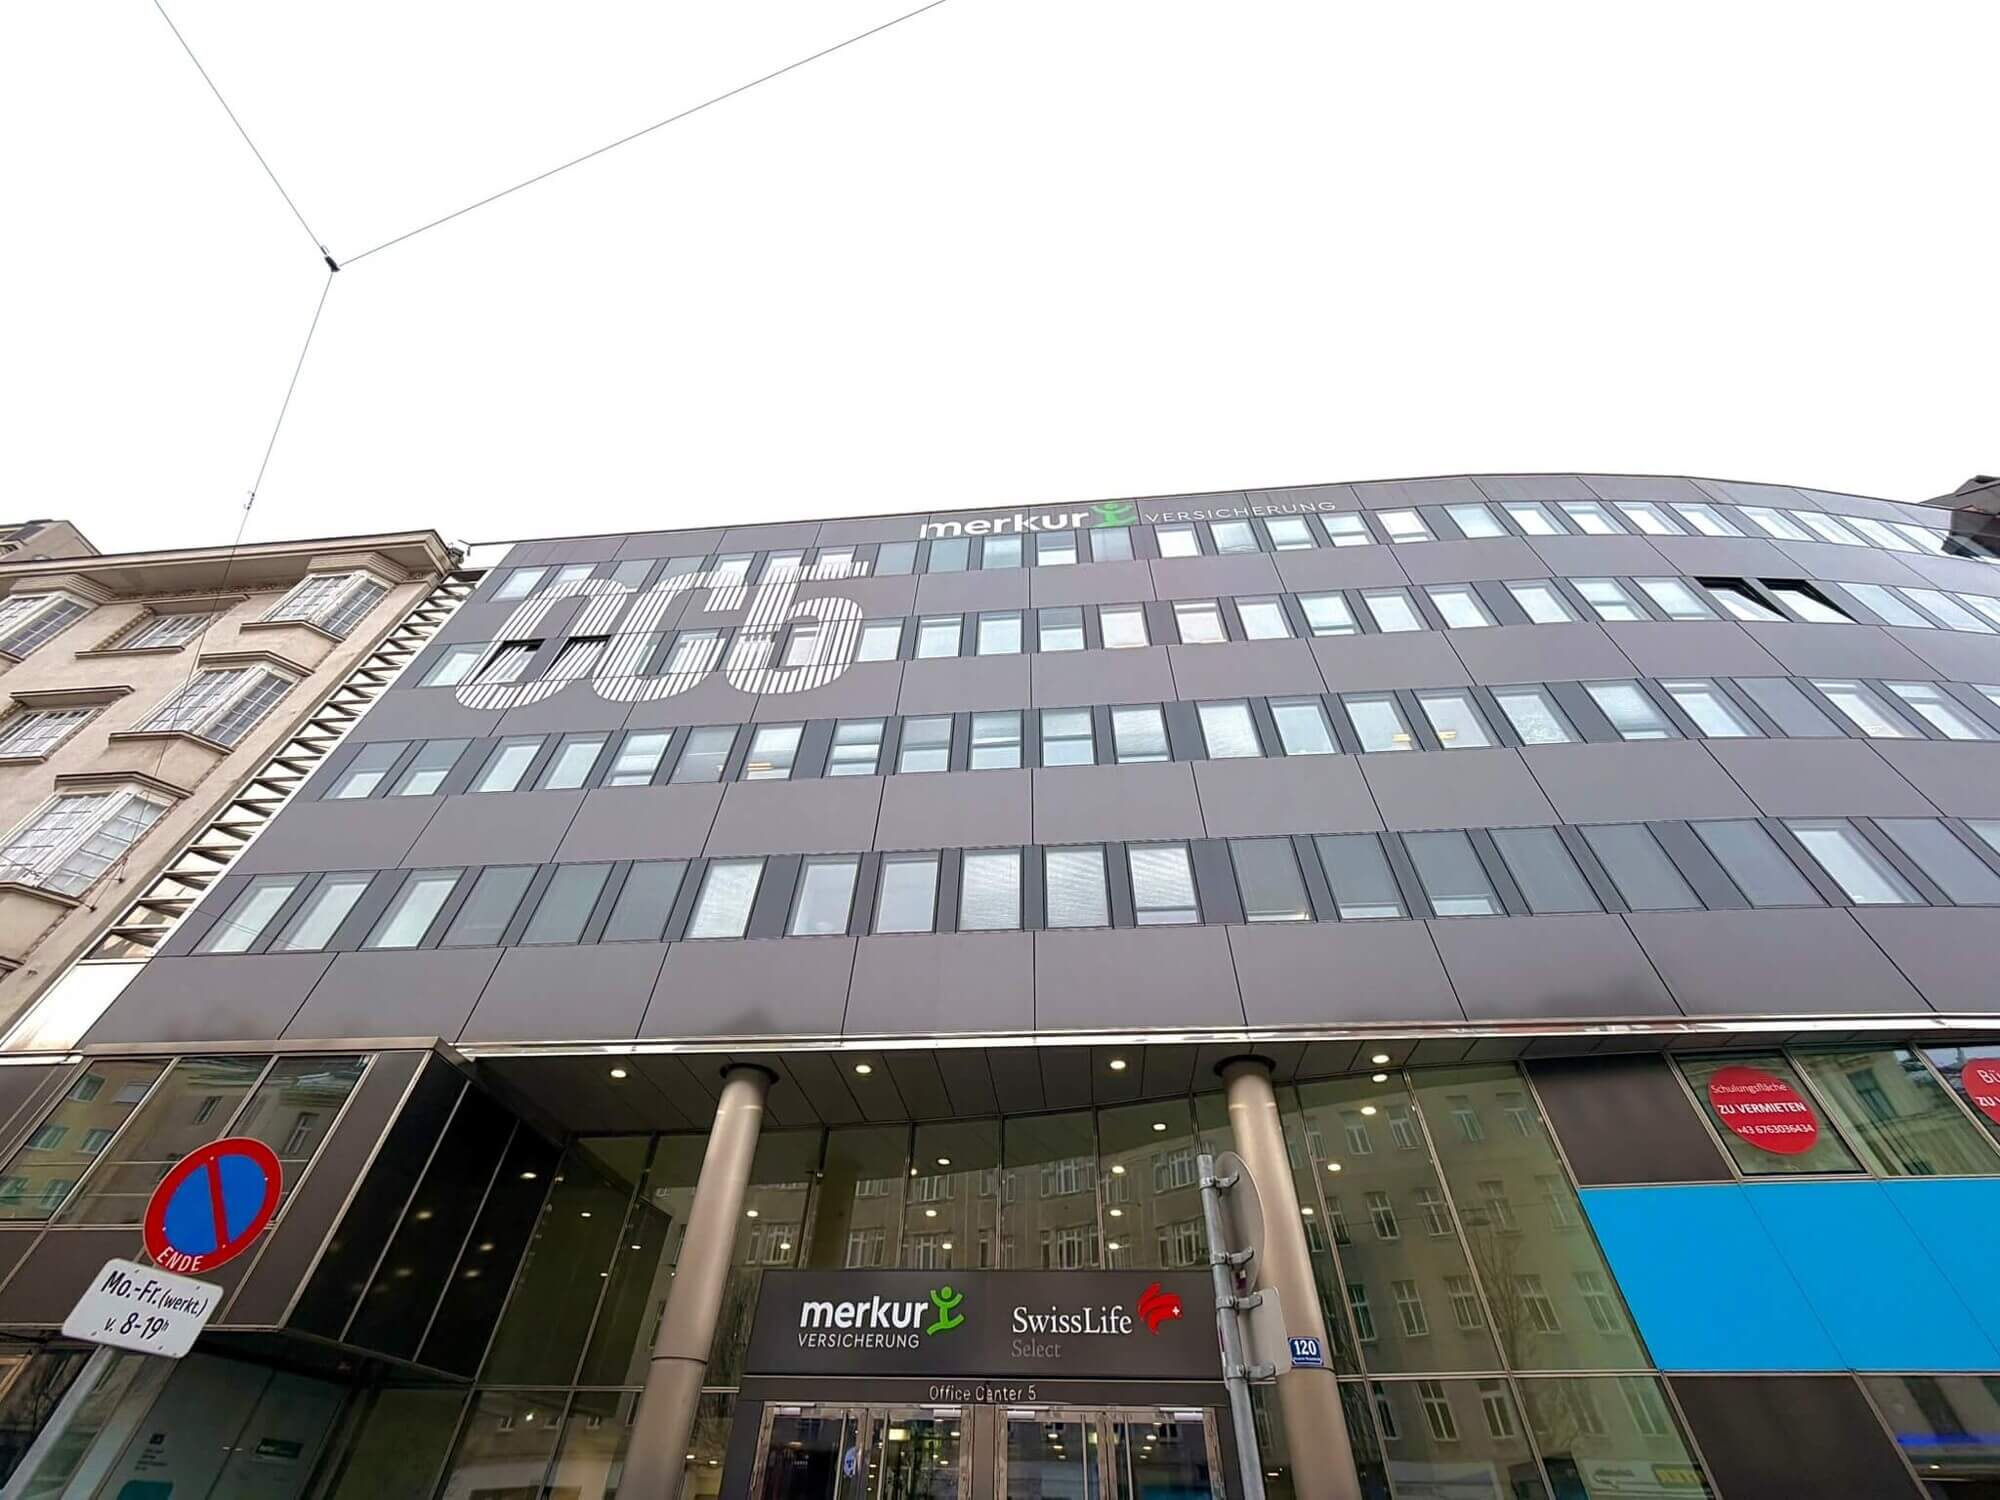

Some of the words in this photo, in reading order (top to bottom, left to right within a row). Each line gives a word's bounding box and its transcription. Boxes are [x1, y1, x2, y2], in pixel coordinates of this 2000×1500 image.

[919, 511, 1090, 540] merkur
[1145, 501, 1337, 523] VERSICHERUNG
[1717, 1104, 1736, 1115] ZU
[1735, 1101, 1808, 1114] VERMIETEN
[1736, 1125, 1755, 1135] +43
[156, 1245, 204, 1272] ENDE
[100, 1270, 162, 1305] Mo.-Fr.
[157, 1288, 209, 1318] (werkt.)
[799, 1295, 929, 1329] merkur
[1012, 1305, 1133, 1334] SwissLife
[104, 1317, 117, 1332] v.
[798, 1332, 920, 1349] VERSICHERUNG
[1011, 1338, 1062, 1358] Select
[1294, 1340, 1317, 1356] 120
[929, 1384, 971, 1401] Office
[975, 1384, 1022, 1401] Center
[1028, 1384, 1037, 1401] 5
